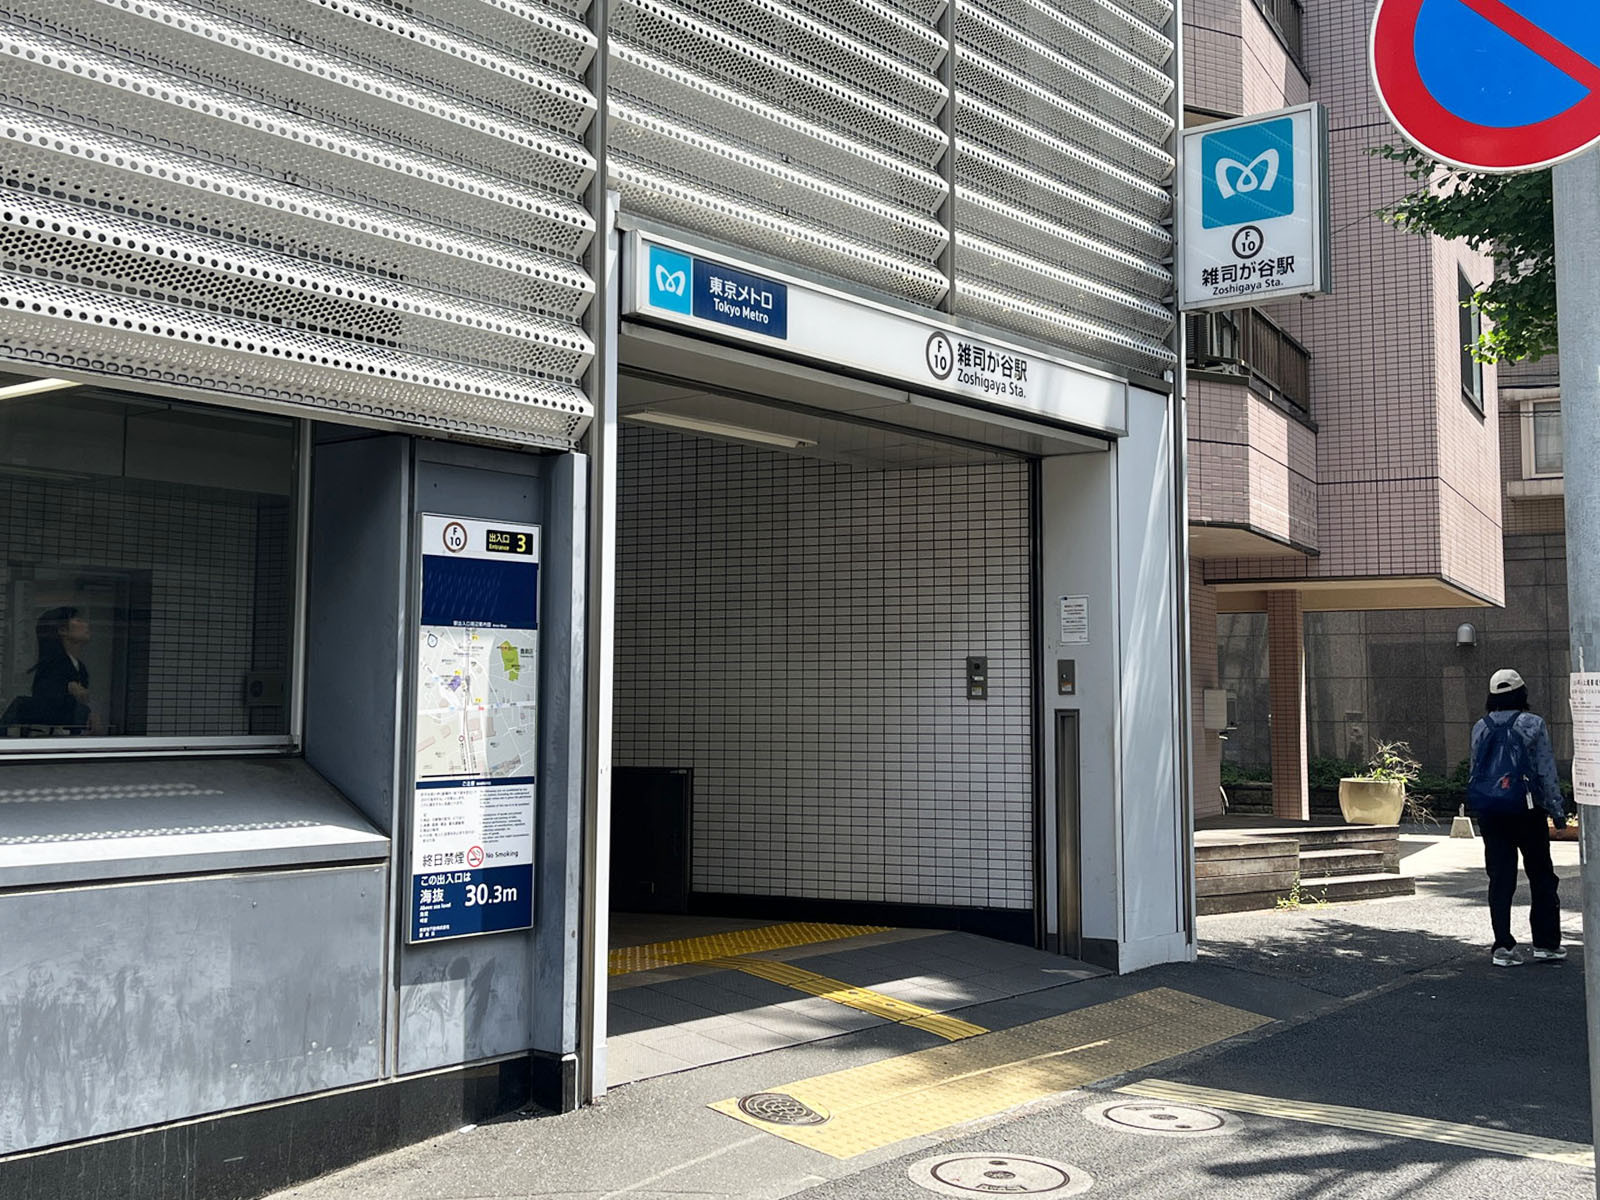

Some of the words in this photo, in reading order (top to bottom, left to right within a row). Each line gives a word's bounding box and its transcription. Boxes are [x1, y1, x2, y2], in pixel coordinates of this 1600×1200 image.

[1245, 231, 1251, 241] F
[1241, 240, 1256, 252] 10
[1201, 255, 1295, 287] 雑司が谷駅
[709, 276, 773, 310] 東京メトロ
[1212, 282, 1262, 296] Zoshigaya
[1265, 278, 1284, 288] Sta.
[713, 297, 741, 318] Tokyo
[742, 305, 769, 324] Metro
[937, 340, 943, 353] F
[934, 354, 947, 371] 10
[957, 341, 1028, 383] 雑司が谷駅
[957, 368, 1007, 395] Zoshigaya
[1008, 381, 1027, 399] Sta.
[453, 527, 458, 536] F
[488, 532, 510, 544] 出入口
[450, 536, 462, 547] 10
[516, 534, 527, 553] 3
[422, 851, 465, 868] 終日禁煙
[486, 851, 494, 859] No
[495, 850, 519, 859] Smoking
[420, 872, 472, 886] この出入口は
[419, 888, 445, 905] 海抜
[465, 883, 517, 907] 30.3m
